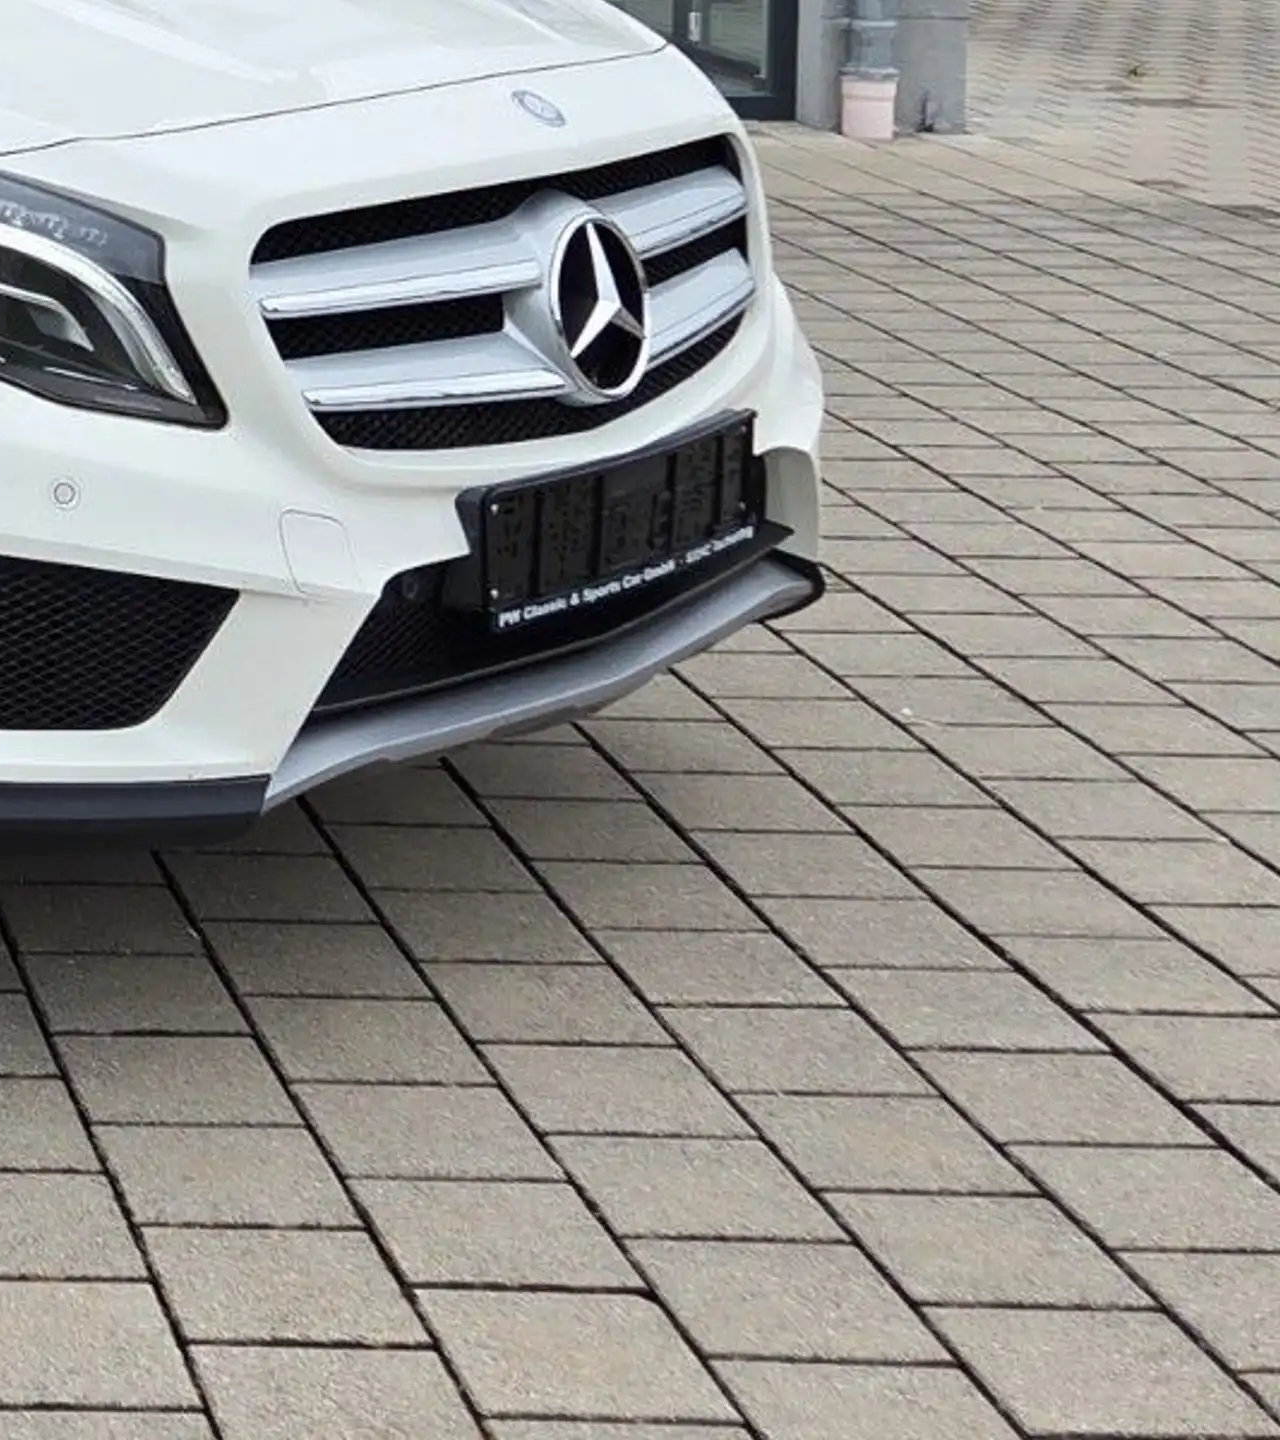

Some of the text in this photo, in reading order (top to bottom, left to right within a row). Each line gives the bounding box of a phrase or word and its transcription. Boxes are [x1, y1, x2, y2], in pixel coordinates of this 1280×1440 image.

[498, 609, 521, 629] PW
[522, 597, 567, 620] Classic
[569, 591, 580, 606] &
[582, 580, 622, 604] Sports
[622, 570, 644, 589] Car
